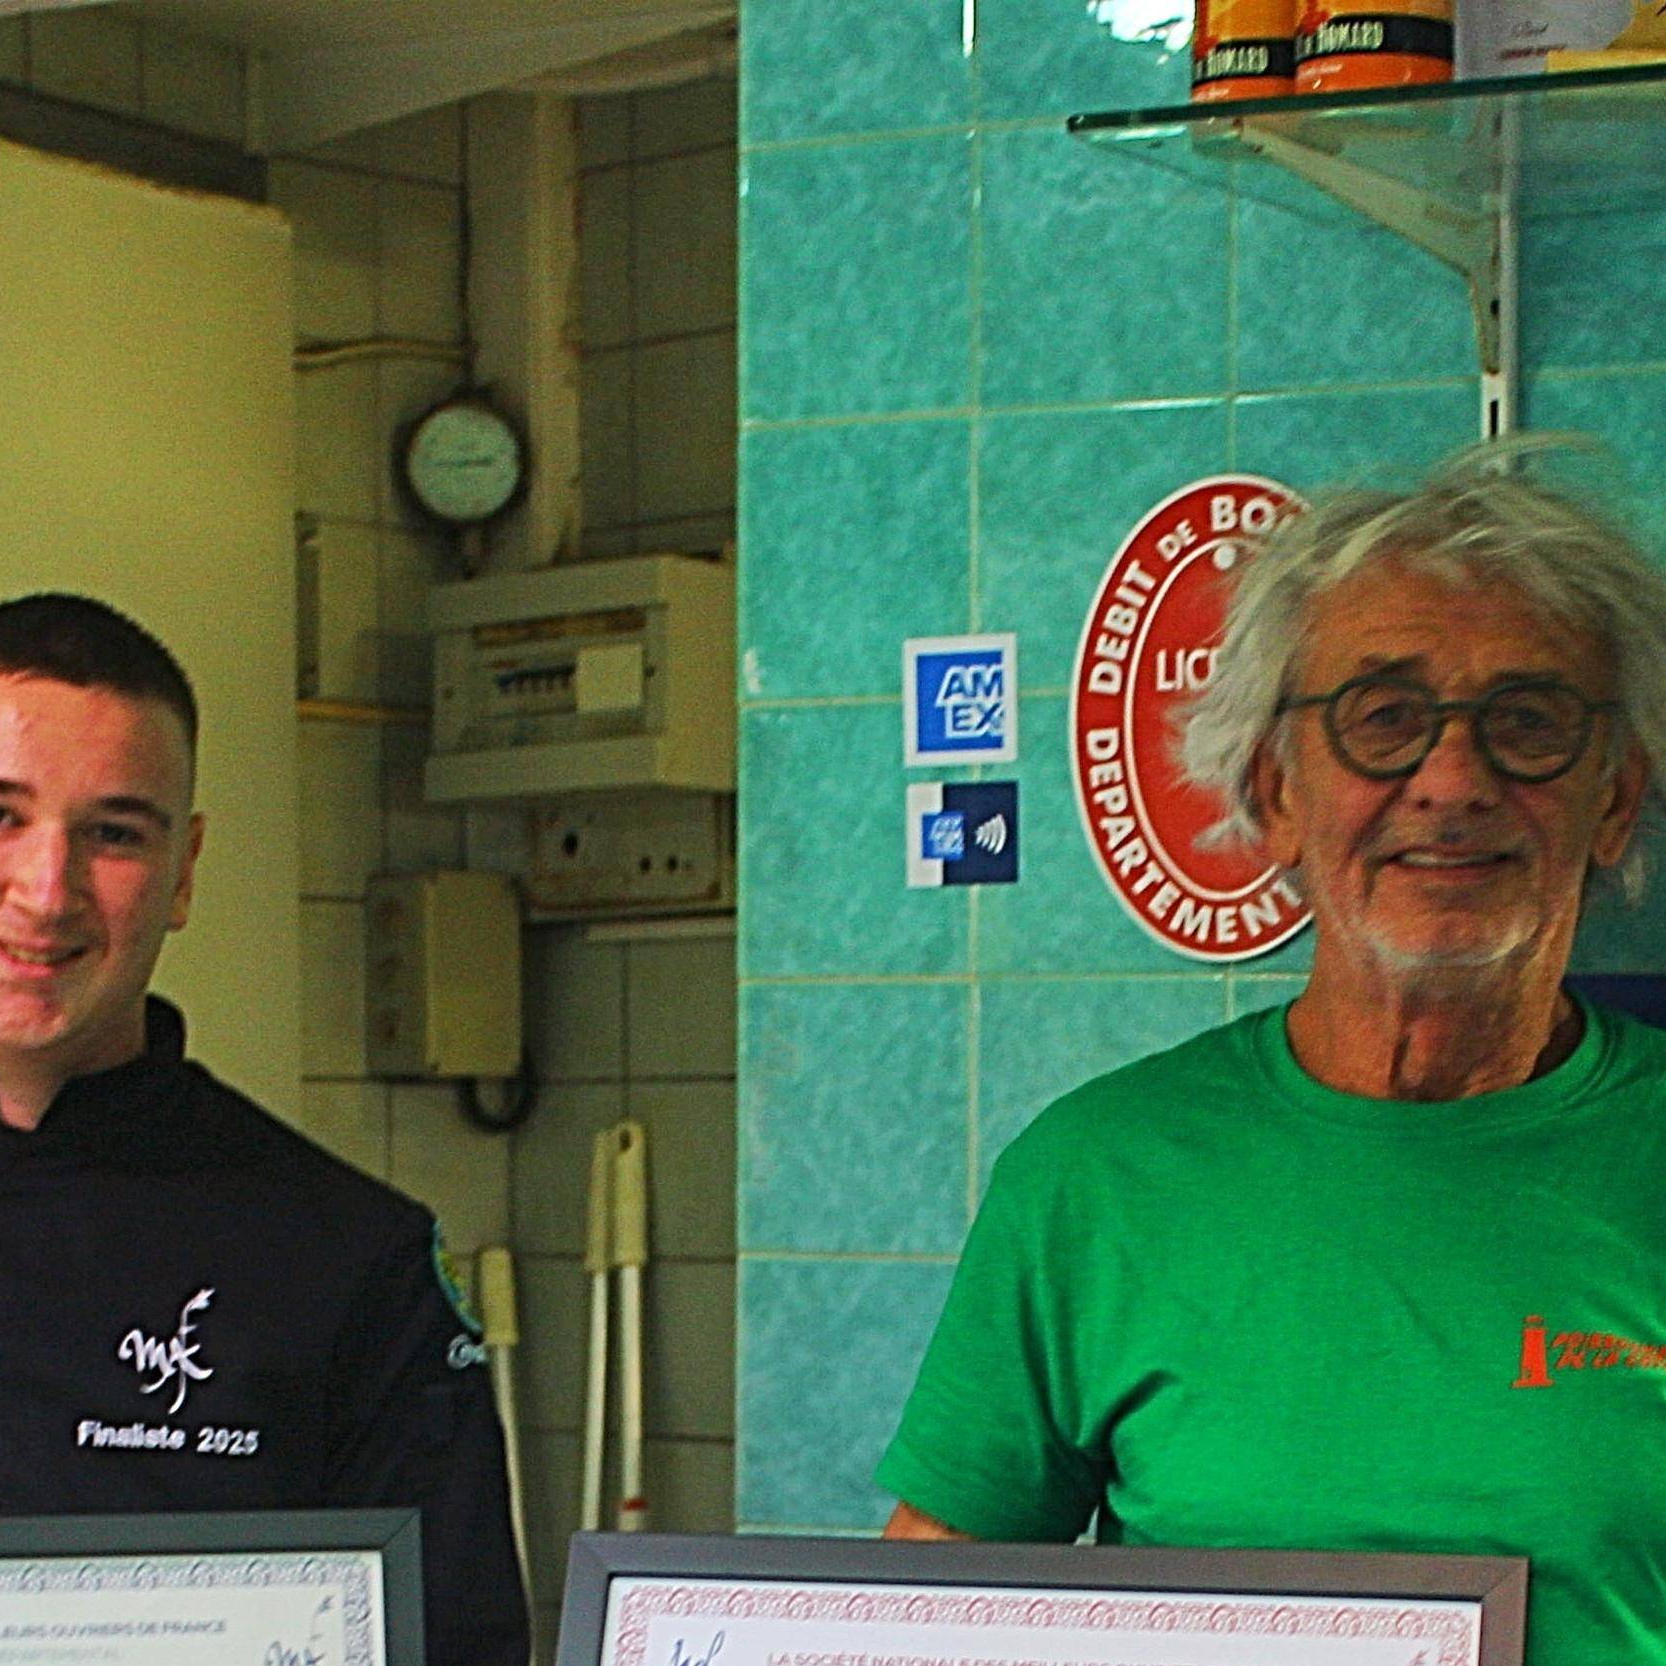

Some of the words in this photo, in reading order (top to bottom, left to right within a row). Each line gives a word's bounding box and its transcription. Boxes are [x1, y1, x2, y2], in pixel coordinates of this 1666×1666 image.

[1088, 561, 1158, 695] DEBIT
[1157, 520, 1199, 561] DE
[77, 1421, 185, 1451] Finaliste
[196, 1427, 259, 1455] 2025
